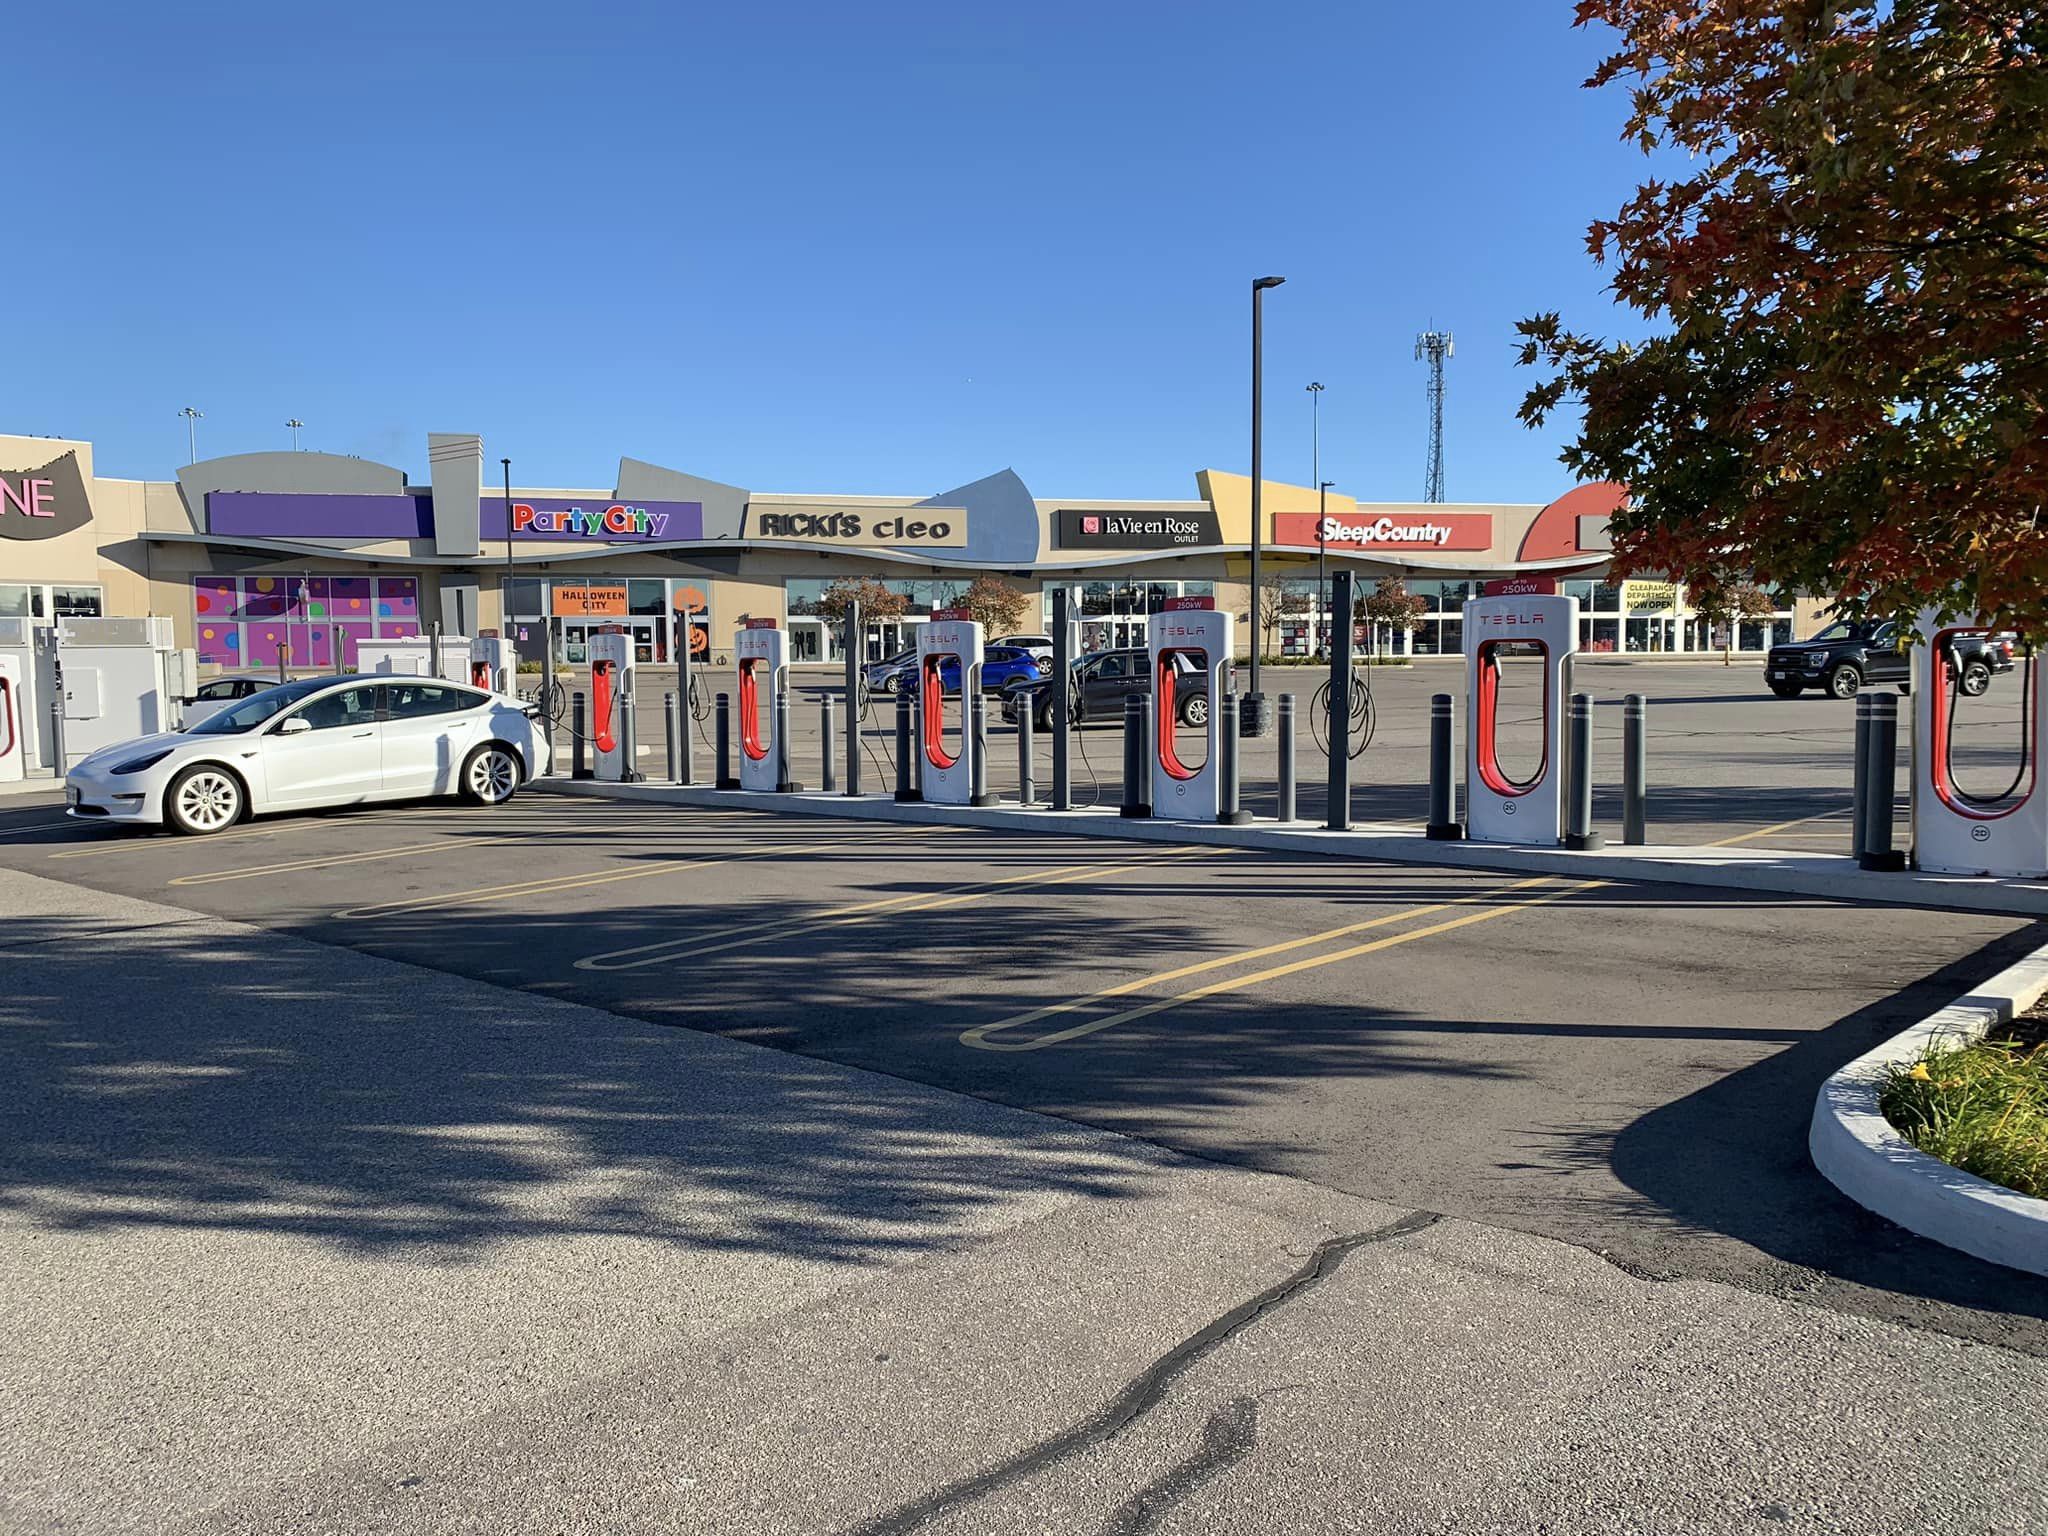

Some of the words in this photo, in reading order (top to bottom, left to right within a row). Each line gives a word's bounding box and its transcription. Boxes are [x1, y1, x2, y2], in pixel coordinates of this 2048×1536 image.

[0, 477, 56, 517] NE
[872, 517, 951, 539] cleo
[1144, 521, 1162, 533] en
[1164, 518, 1199, 533] Rose
[1174, 535, 1199, 543] OUTLET
[1502, 584, 1537, 594] 250kW
[1629, 584, 1674, 592] CLEARANCE
[562, 591, 625, 600] HALLOWEEN
[582, 600, 607, 609] CITY
[1626, 600, 1647, 609] NOW
[1480, 614, 1544, 625] TESLA
[1160, 626, 1205, 636] TESLA
[924, 634, 959, 643] TESLA
